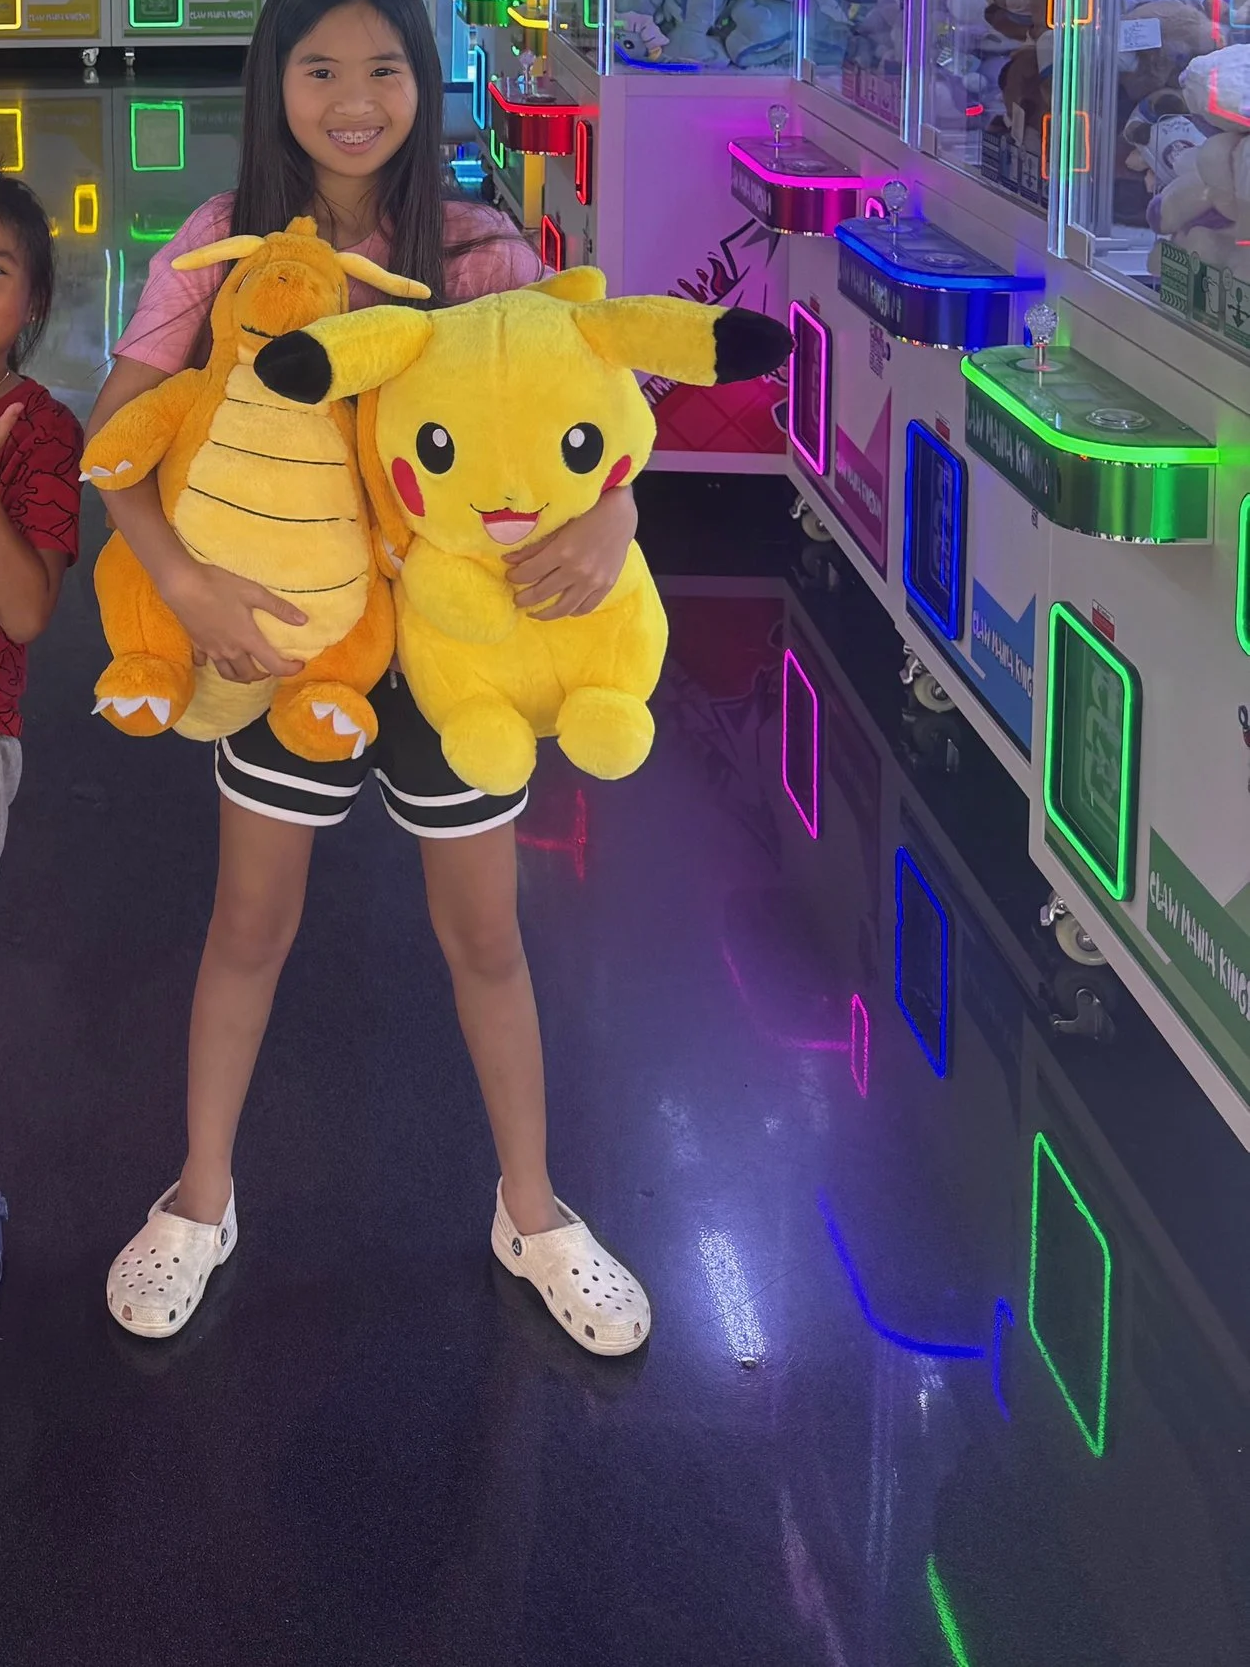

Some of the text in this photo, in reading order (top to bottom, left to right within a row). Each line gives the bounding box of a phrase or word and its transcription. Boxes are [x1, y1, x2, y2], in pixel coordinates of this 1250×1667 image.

[986, 412, 1014, 469] MANIA
[991, 629, 1014, 678] MANIA
[1149, 871, 1179, 929] CLAW
[1181, 903, 1216, 978] MANIA
